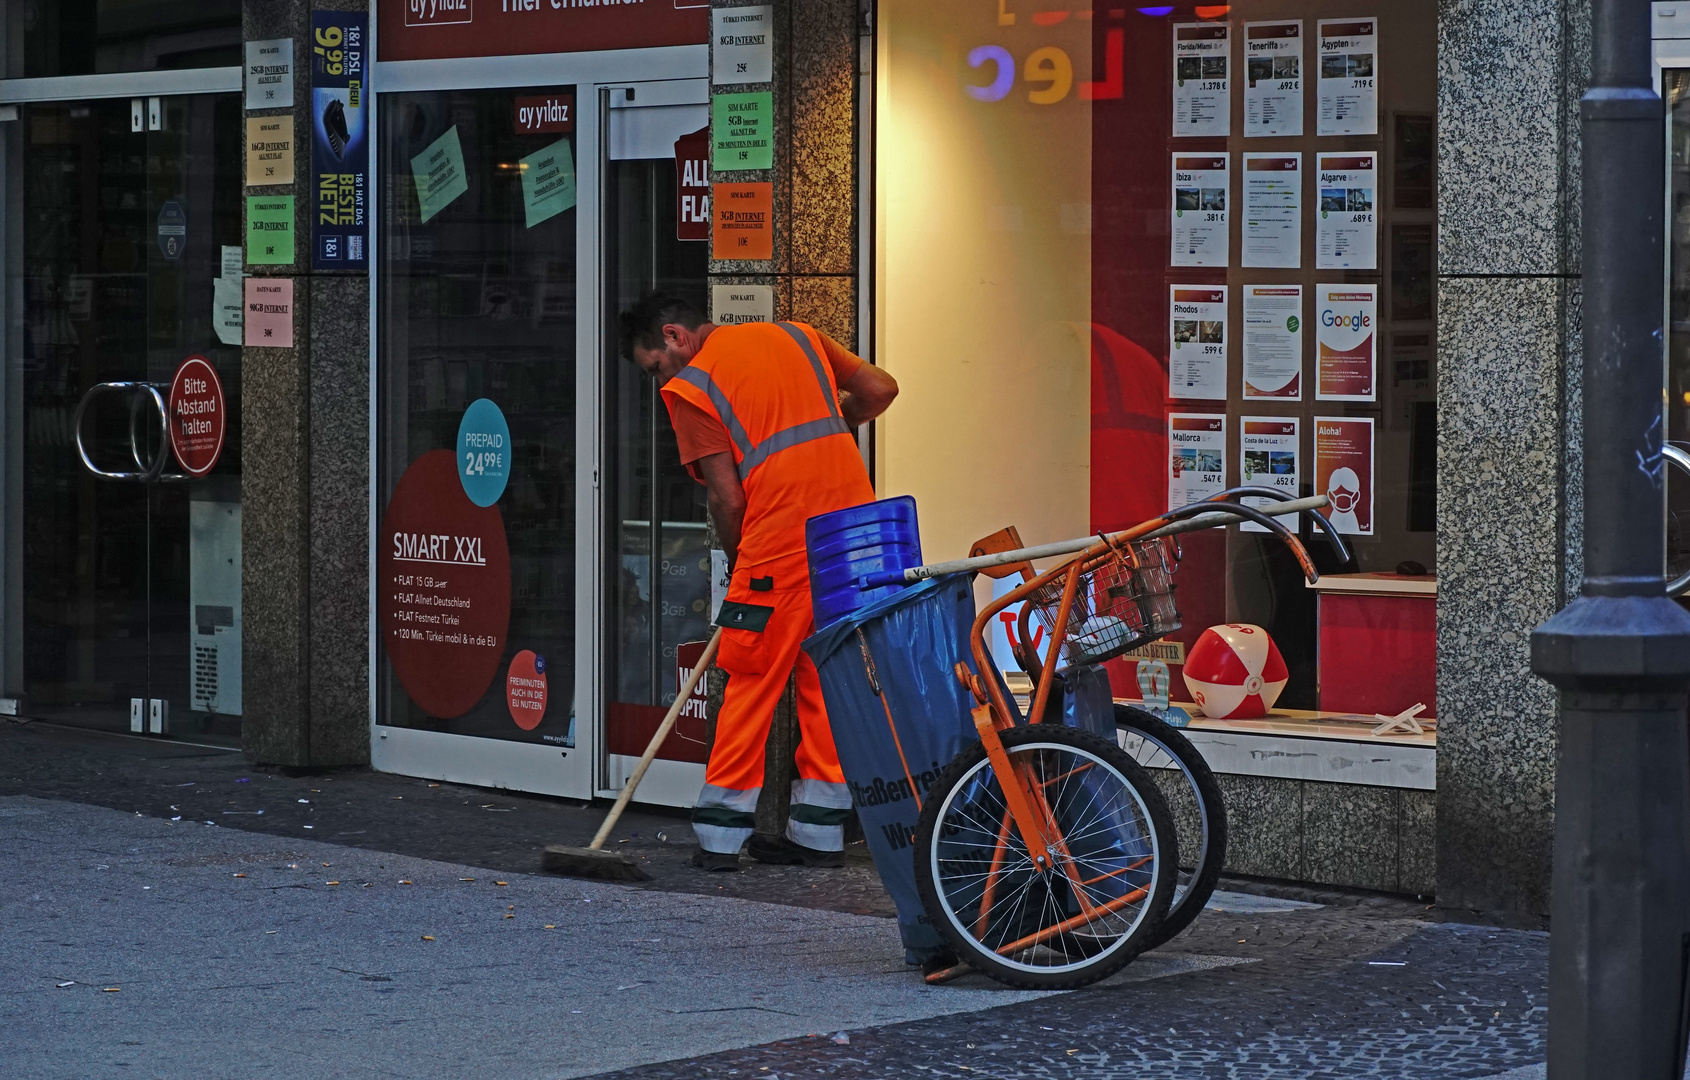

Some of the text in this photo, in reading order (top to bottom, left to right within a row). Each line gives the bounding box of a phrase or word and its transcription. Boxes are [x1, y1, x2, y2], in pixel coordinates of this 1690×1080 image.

[740, 14, 763, 22] INTERNET
[720, 35, 765, 46] 8GB INTERNET
[1248, 41, 1278, 50] Teneriffa
[1321, 38, 1349, 50] Ägypten
[349, 25, 361, 75] 1&1 DSL
[1177, 43, 1212, 51] Florida/Miami
[250, 64, 289, 75] 25GB INTERNET
[737, 63, 748, 73] 25€
[1202, 81, 1226, 90] 1.378 €
[1280, 81, 1299, 90] 692 €
[1354, 79, 1373, 88] 719 €
[350, 83, 359, 105] NEU!
[727, 102, 758, 112] SIM KARTE
[728, 116, 742, 126] 5GB
[730, 128, 748, 136] ALLNET
[251, 141, 289, 152] 16GB INTERNET
[738, 150, 748, 160] 15€
[1176, 173, 1191, 181] Ibiza
[1321, 173, 1347, 184] Algarve
[320, 174, 338, 225] NETZ
[339, 174, 355, 225] BESTE
[355, 173, 363, 226] 1&1 HAT DAS
[720, 211, 765, 222] 3GB INTERNET
[1206, 213, 1225, 221] 381 €
[1353, 214, 1372, 222] 689 €
[253, 221, 288, 231] 2GB INTERNET
[326, 238, 337, 257] 1&1
[738, 237, 748, 247] 10€
[249, 303, 288, 313] 90GB INTERNET
[1174, 305, 1198, 313] Rhodos
[720, 313, 765, 324] 6GB INTERNET
[1321, 309, 1370, 332] Google
[1204, 346, 1223, 354] 599 €
[184, 378, 207, 395] Bitte
[177, 396, 216, 415] Abstand
[182, 418, 212, 435] halten
[1318, 426, 1342, 436] Aloha!
[465, 433, 503, 448] PREPAID
[1173, 433, 1200, 442] Mallorca
[1203, 474, 1222, 483] 547 €
[1276, 477, 1294, 486] 652 €
[393, 532, 486, 562] SMART XXL
[398, 575, 434, 587] FLAT 15 GB
[398, 593, 471, 608] FLAT Allnet Deutschland
[398, 610, 460, 625] FLAT Festnetz Türkei
[398, 628, 496, 647] 120 Min. Türkei mobil & in die EU
[1142, 644, 1150, 657] IS
[1150, 644, 1180, 660] BETTER
[509, 677, 545, 689] FREIMINUTEN
[511, 688, 543, 700] AUCH IN DIE
[512, 699, 542, 710] EU NUTZEN
